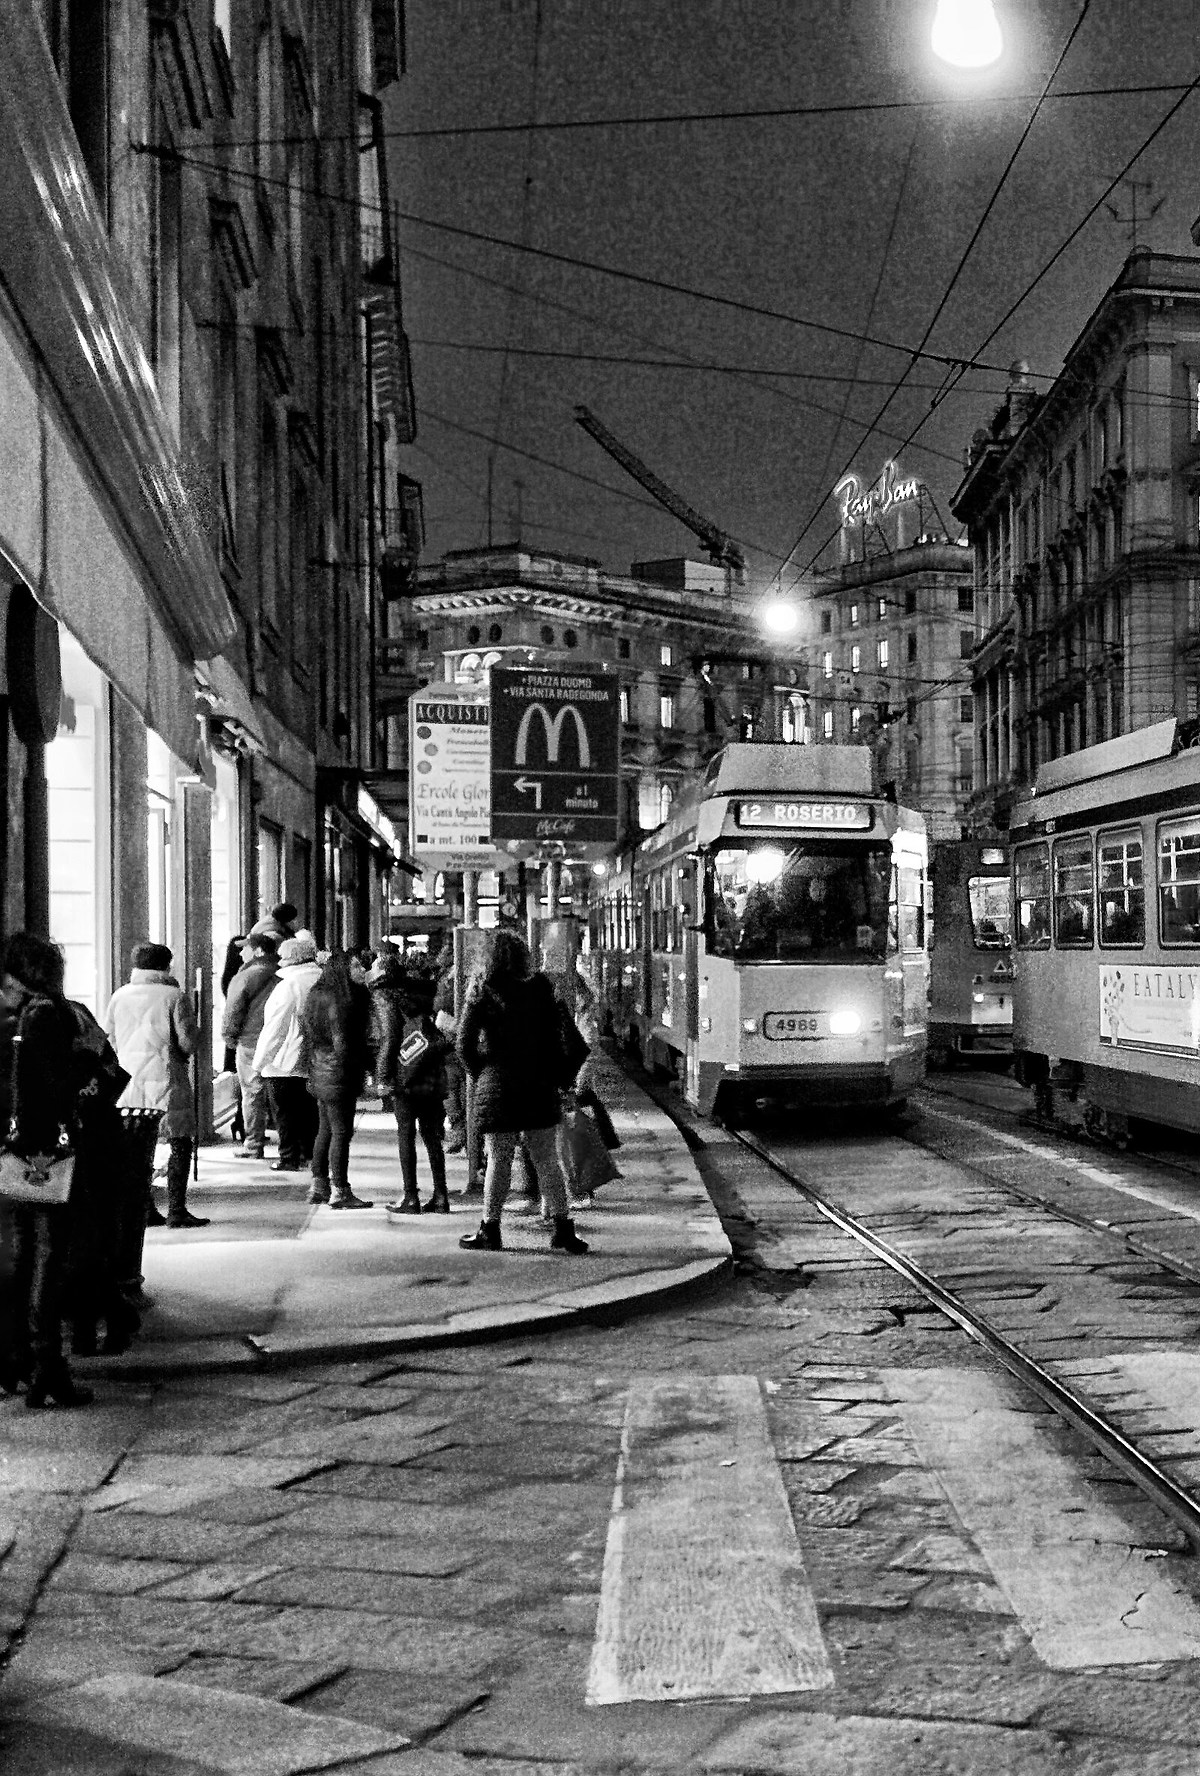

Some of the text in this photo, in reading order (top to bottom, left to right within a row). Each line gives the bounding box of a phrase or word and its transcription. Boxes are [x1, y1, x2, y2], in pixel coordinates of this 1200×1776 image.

[528, 675, 592, 689] PIAZZA DUOMO
[509, 686, 609, 701] VIA SANTA RADEGONDA
[417, 704, 488, 723] ACQUISTI
[417, 780, 459, 799] Ercole
[416, 804, 429, 817] Via
[565, 797, 598, 809] minuto
[741, 804, 857, 822] 12 ROSERIO
[460, 835, 478, 845] 100
[1133, 973, 1197, 999] EATALY
